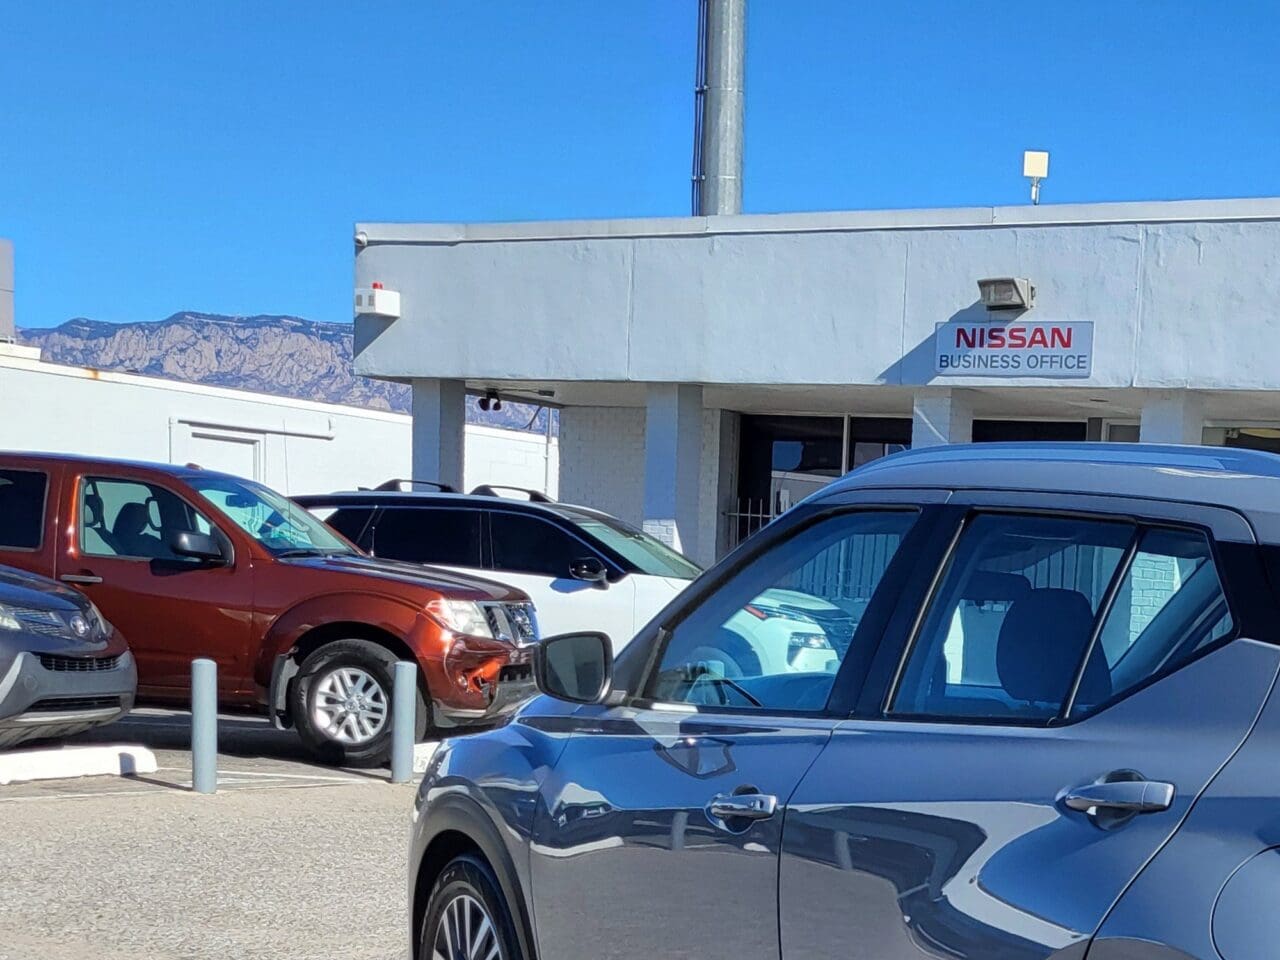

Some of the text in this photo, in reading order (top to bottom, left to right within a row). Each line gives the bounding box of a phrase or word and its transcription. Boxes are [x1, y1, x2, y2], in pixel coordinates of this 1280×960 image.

[956, 328, 1073, 348] NISSAN
[939, 355, 1087, 369] BUSINESS OFFICE
